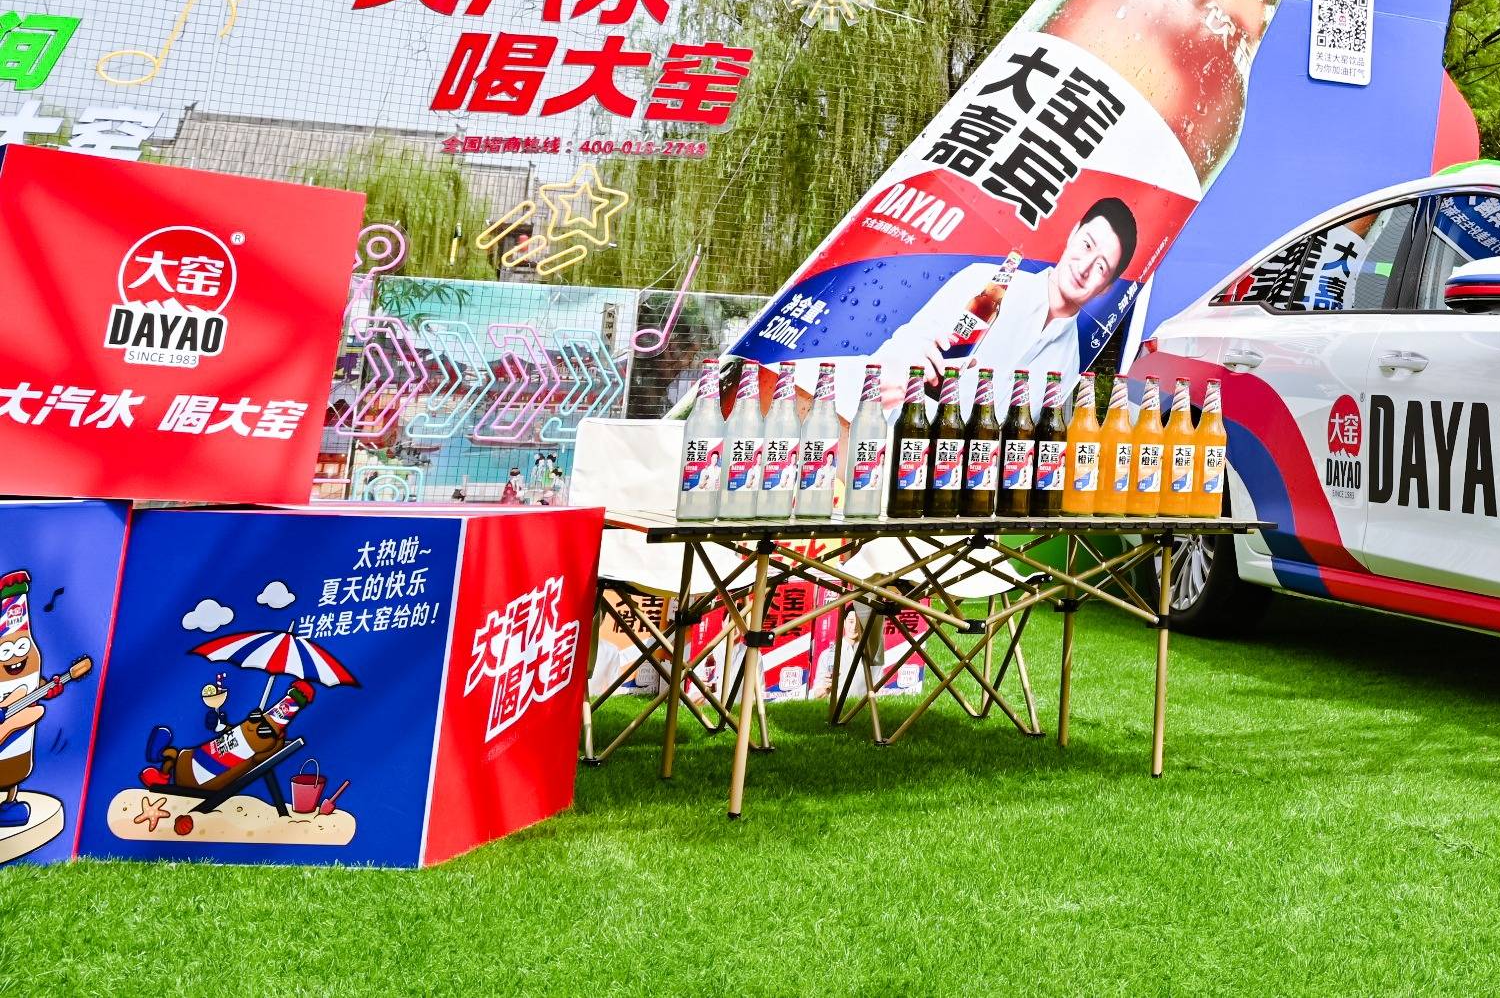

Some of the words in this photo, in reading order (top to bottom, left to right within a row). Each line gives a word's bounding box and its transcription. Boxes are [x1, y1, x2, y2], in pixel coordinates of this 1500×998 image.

[429, 32, 754, 126] 喝大窑
[976, 47, 1125, 159] 大窑
[921, 103, 1078, 226] 嘉宾
[872, 183, 965, 242] DAYAO
[128, 251, 224, 296] 大窑
[109, 308, 224, 353] DAYAO
[759, 315, 808, 349] 520mL
[128, 350, 164, 363] SINCE
[169, 353, 197, 365] 1983
[0, 383, 145, 429] 大汽水
[157, 394, 308, 440] 喝大窑
[1330, 413, 1358, 444] 大窑
[1326, 458, 1361, 489] DAYAO
[353, 536, 431, 570] 太热啦~
[318, 567, 429, 607] 夏天的快乐
[297, 602, 440, 639] 当然是大窑给的！
